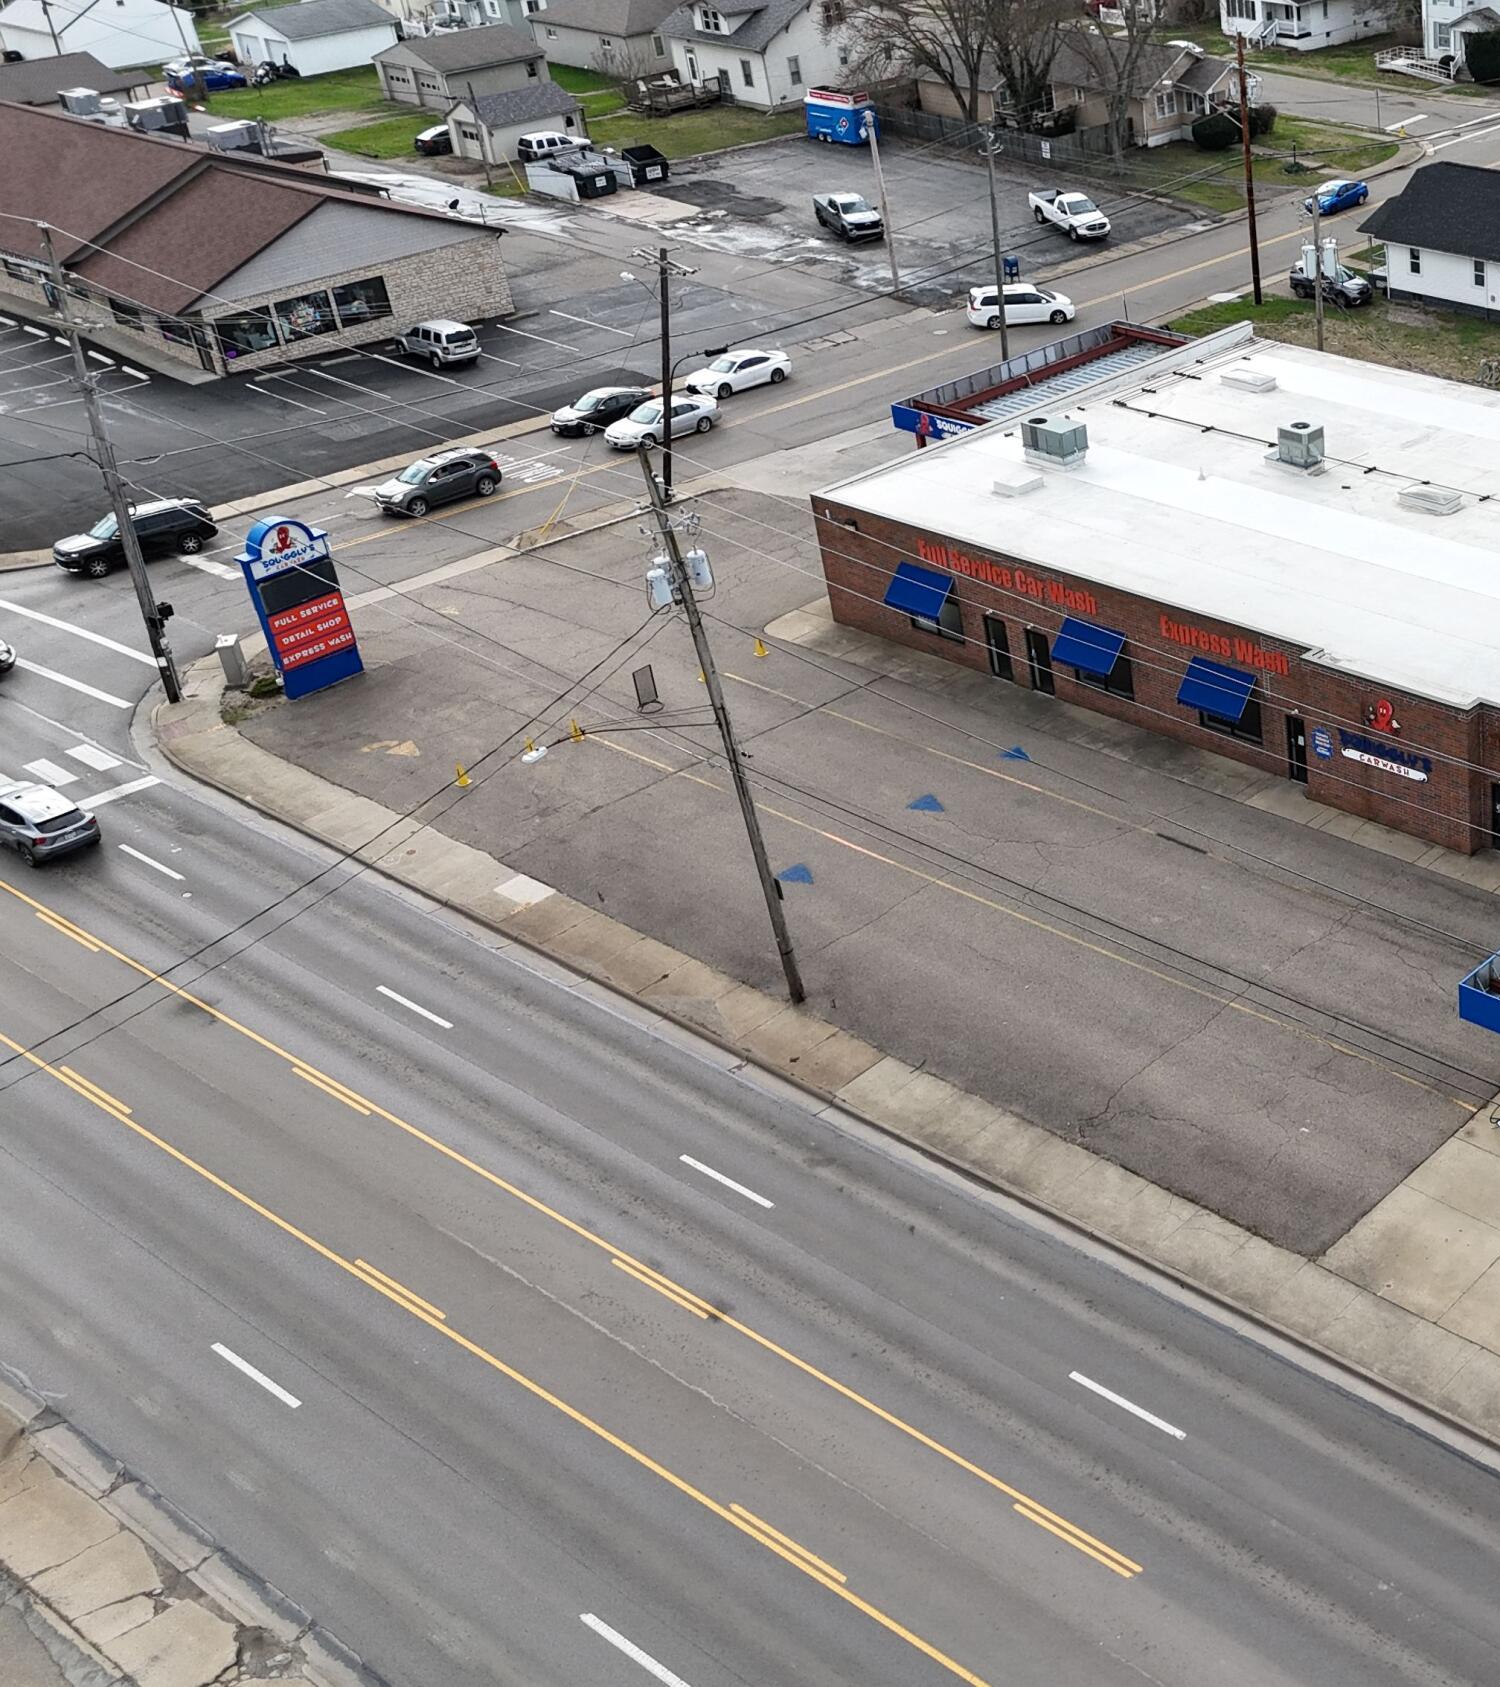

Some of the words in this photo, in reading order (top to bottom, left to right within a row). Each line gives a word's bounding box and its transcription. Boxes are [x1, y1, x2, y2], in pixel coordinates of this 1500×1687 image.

[935, 417, 970, 434] SQUIGG
[916, 538, 947, 566] Full
[948, 550, 1013, 588] Service
[1015, 569, 1045, 599] Car
[1046, 580, 1097, 616] Wash
[274, 615, 298, 628] FULL
[300, 599, 338, 618] SERVICE
[282, 628, 314, 645] DETAIL
[316, 616, 341, 631] SHOP
[283, 643, 325, 664] EXPRESS
[327, 632, 352, 646] WASH
[1159, 615, 1232, 657] Express
[1234, 637, 1289, 676] Wash
[1359, 754, 1411, 776] CARWASH
